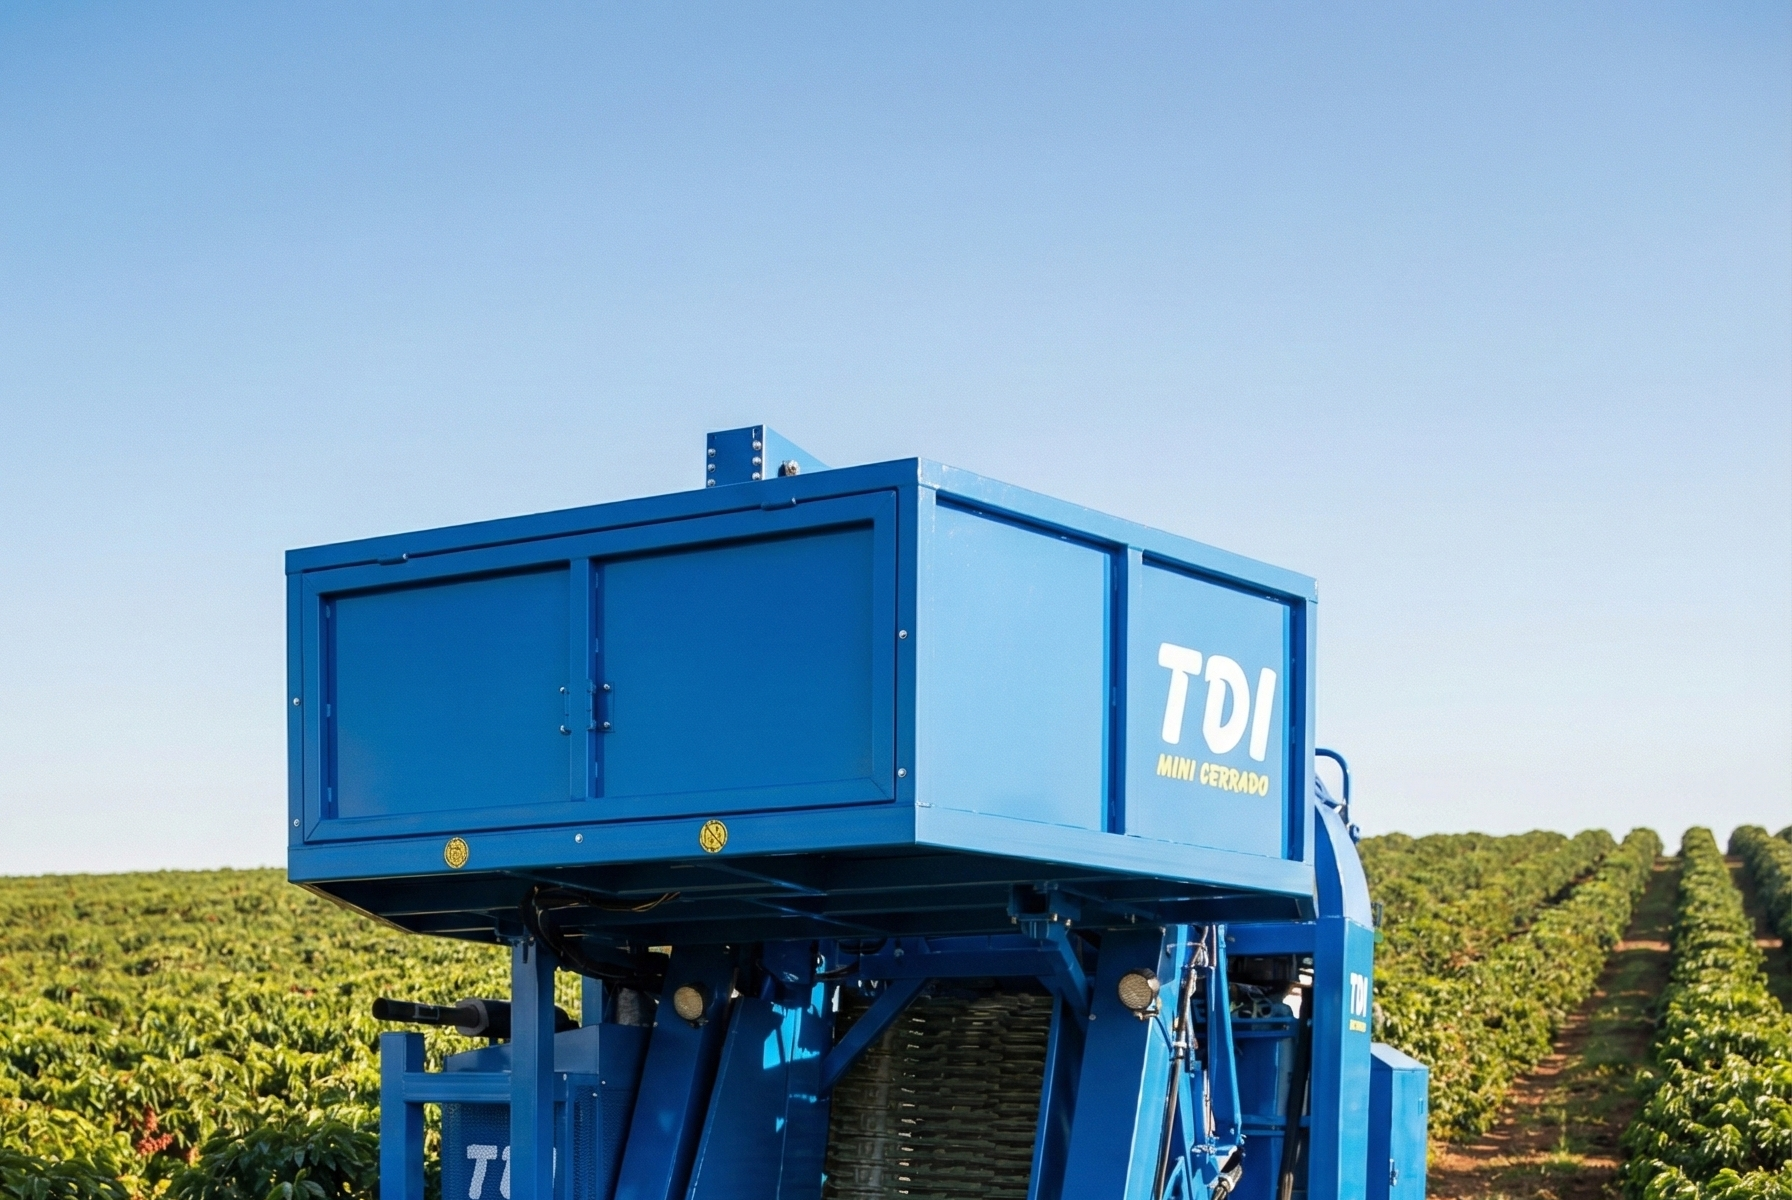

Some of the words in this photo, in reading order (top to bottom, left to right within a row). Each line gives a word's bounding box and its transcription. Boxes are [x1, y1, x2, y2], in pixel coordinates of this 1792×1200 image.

[1158, 642, 1277, 762] TDI
[1156, 753, 1196, 781] MINI
[1200, 762, 1269, 797] CERRADO
[1350, 972, 1368, 1018] TDI
